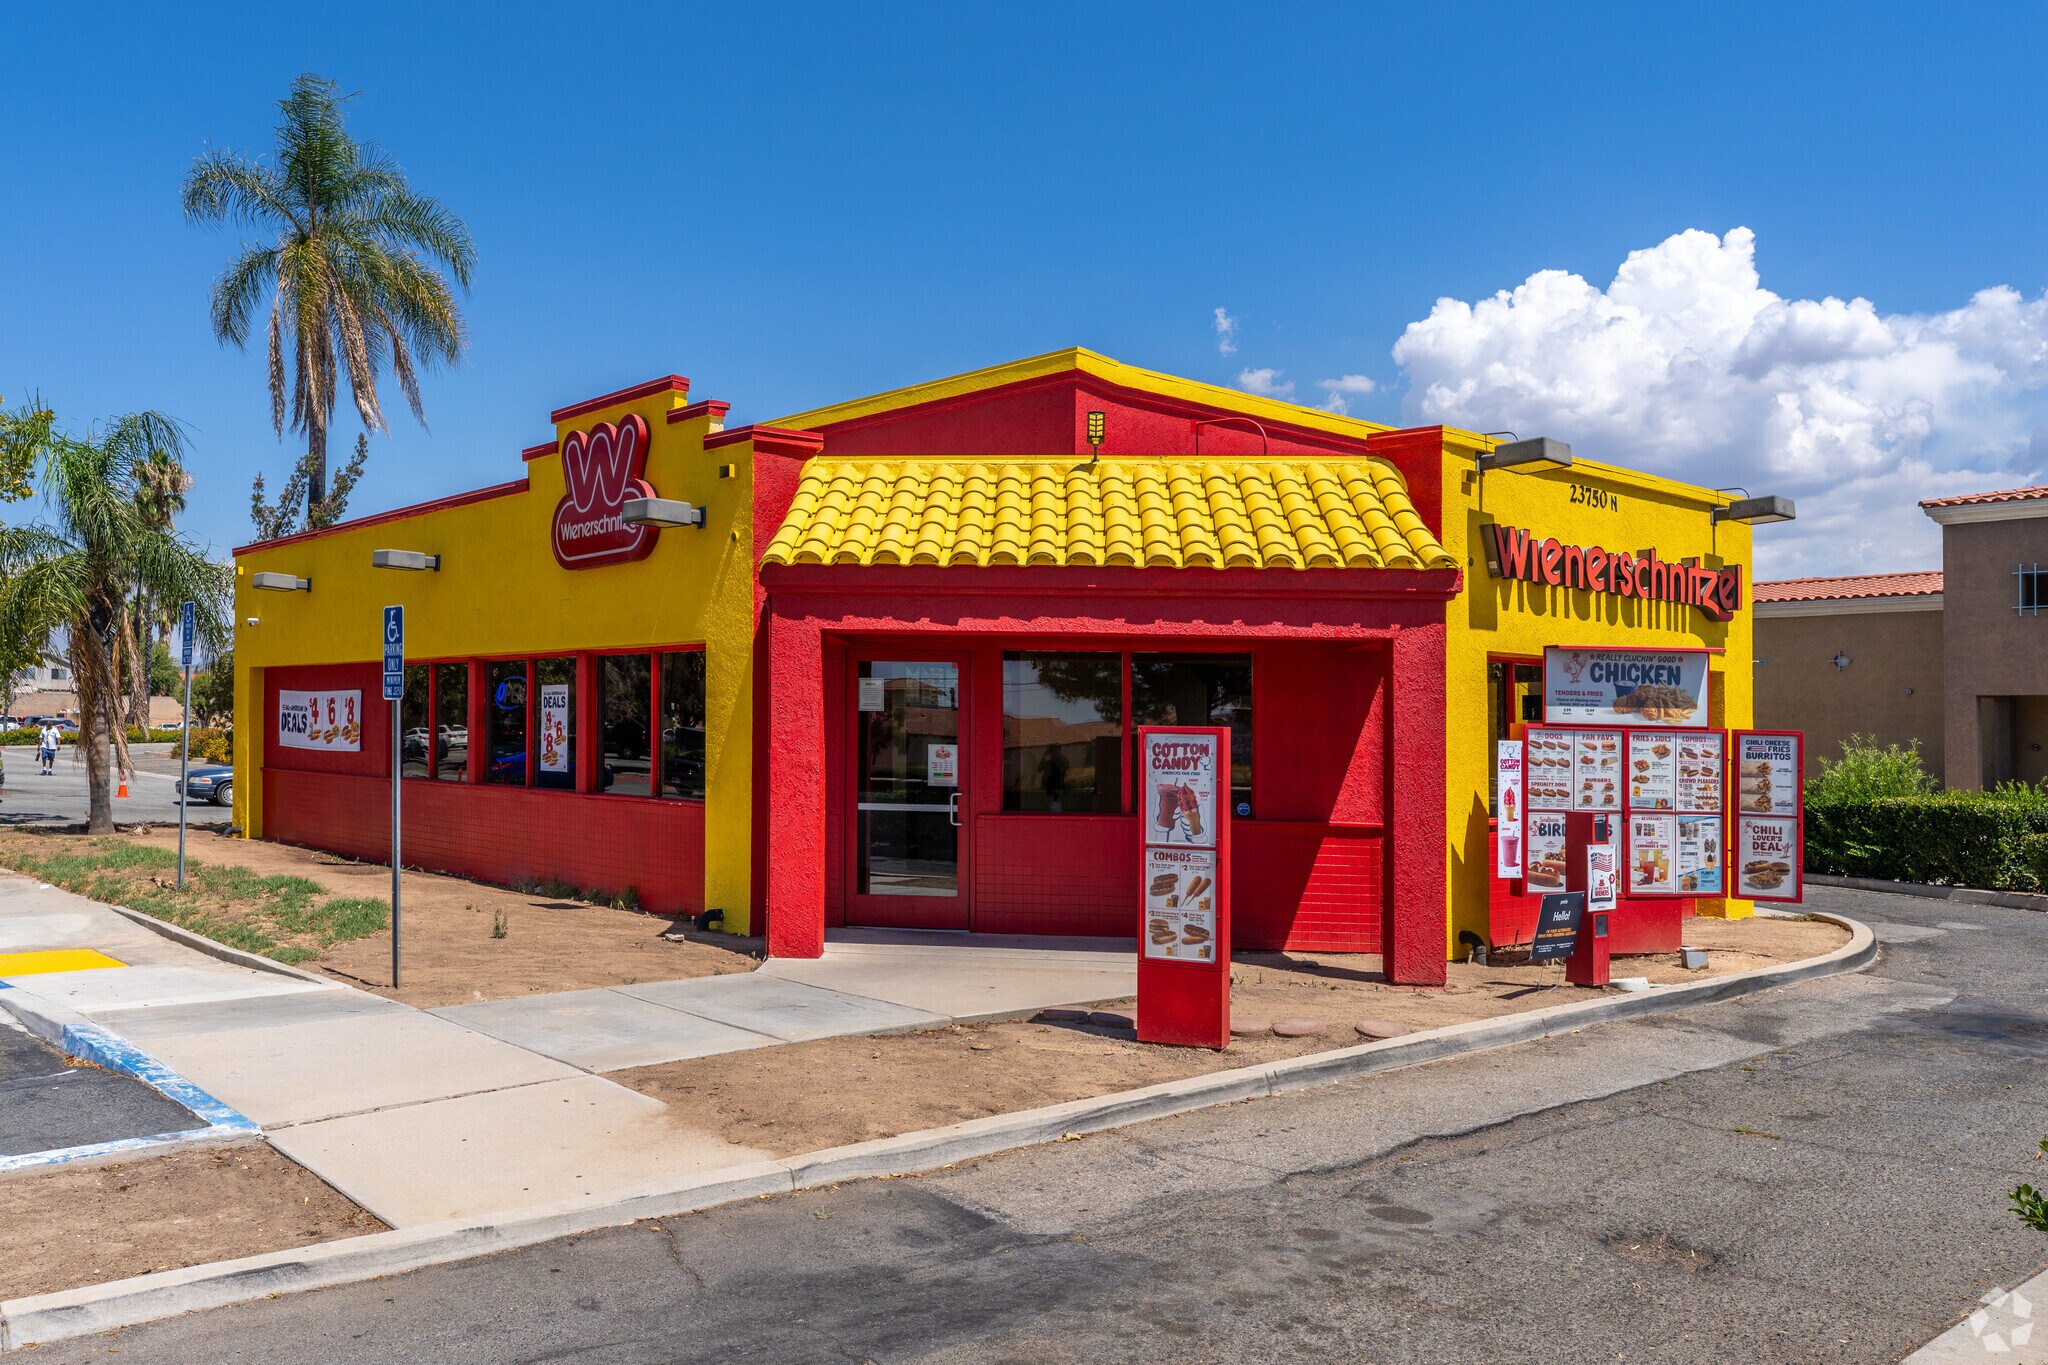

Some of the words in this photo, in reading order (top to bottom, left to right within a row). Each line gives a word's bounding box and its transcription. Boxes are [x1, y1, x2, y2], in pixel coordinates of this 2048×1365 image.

[1569, 484, 1608, 509] 23750
[1611, 493, 1618, 513] N
[560, 513, 640, 542] Wienerschnitz
[1491, 522, 1743, 623] Wienerschnitzel
[384, 642, 403, 656] PARKING
[387, 657, 400, 671] ONLY
[1596, 653, 1622, 662] REALLY
[1624, 654, 1656, 663] CLUCKIN'
[1658, 655, 1677, 663] GOOD
[1589, 661, 1682, 686] CHICKEN
[543, 695, 566, 709] DEALS
[281, 711, 308, 734] DEALS
[308, 697, 319, 725] $4
[326, 697, 336, 726] $6
[344, 696, 355, 725] $8
[553, 720, 563, 739] $6
[543, 732, 554, 754] $8
[1151, 743, 1210, 757] COTTON
[1151, 755, 1200, 770] CANDY
[1746, 752, 1791, 761] BURRITOS
[1752, 825, 1783, 835] CHILI
[1752, 841, 1782, 851] DEAL
[1153, 851, 1192, 863] COMBOS
[1553, 910, 1571, 922] Hello!
